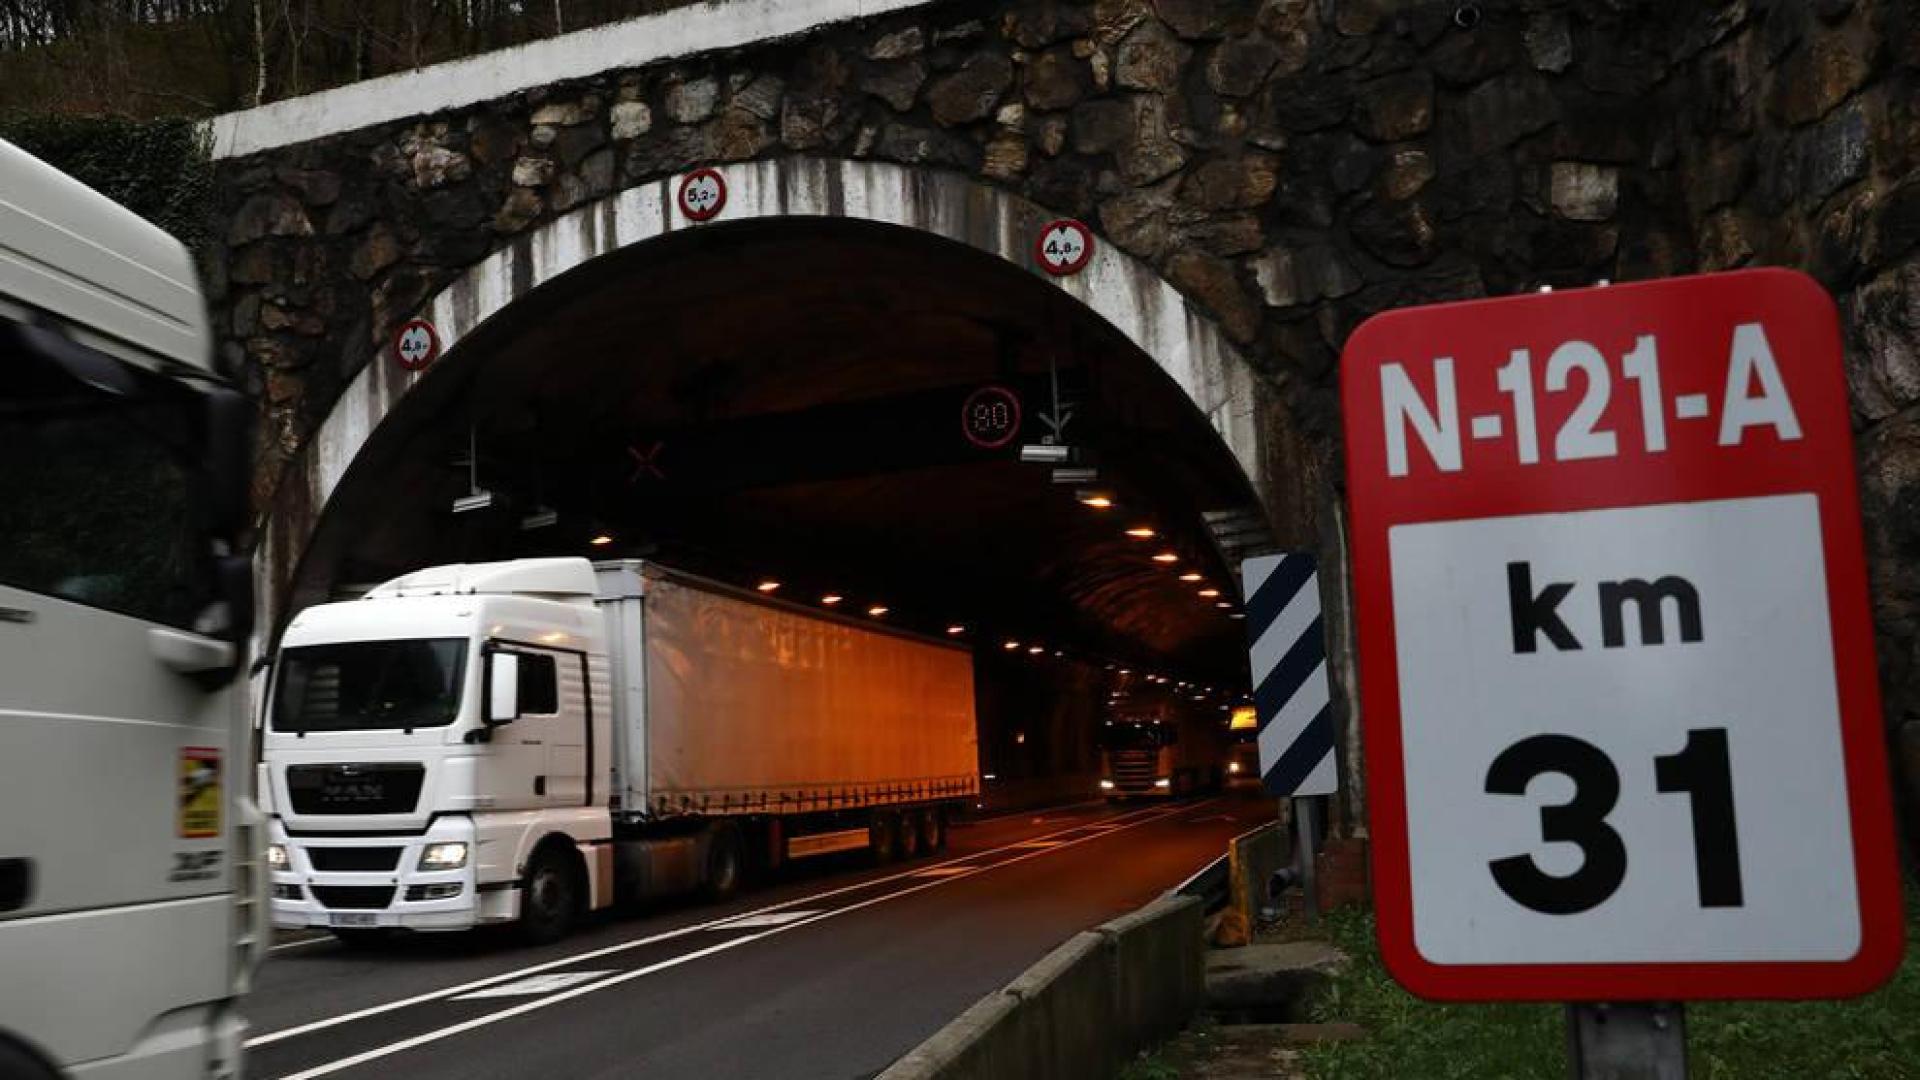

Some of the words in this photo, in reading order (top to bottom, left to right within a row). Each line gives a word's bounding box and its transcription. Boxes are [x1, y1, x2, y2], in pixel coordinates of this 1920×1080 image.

[974, 402, 1008, 431] 80
[1380, 322, 1802, 477] N-121-A
[1506, 561, 1704, 654] km
[1484, 728, 1744, 915] 31
